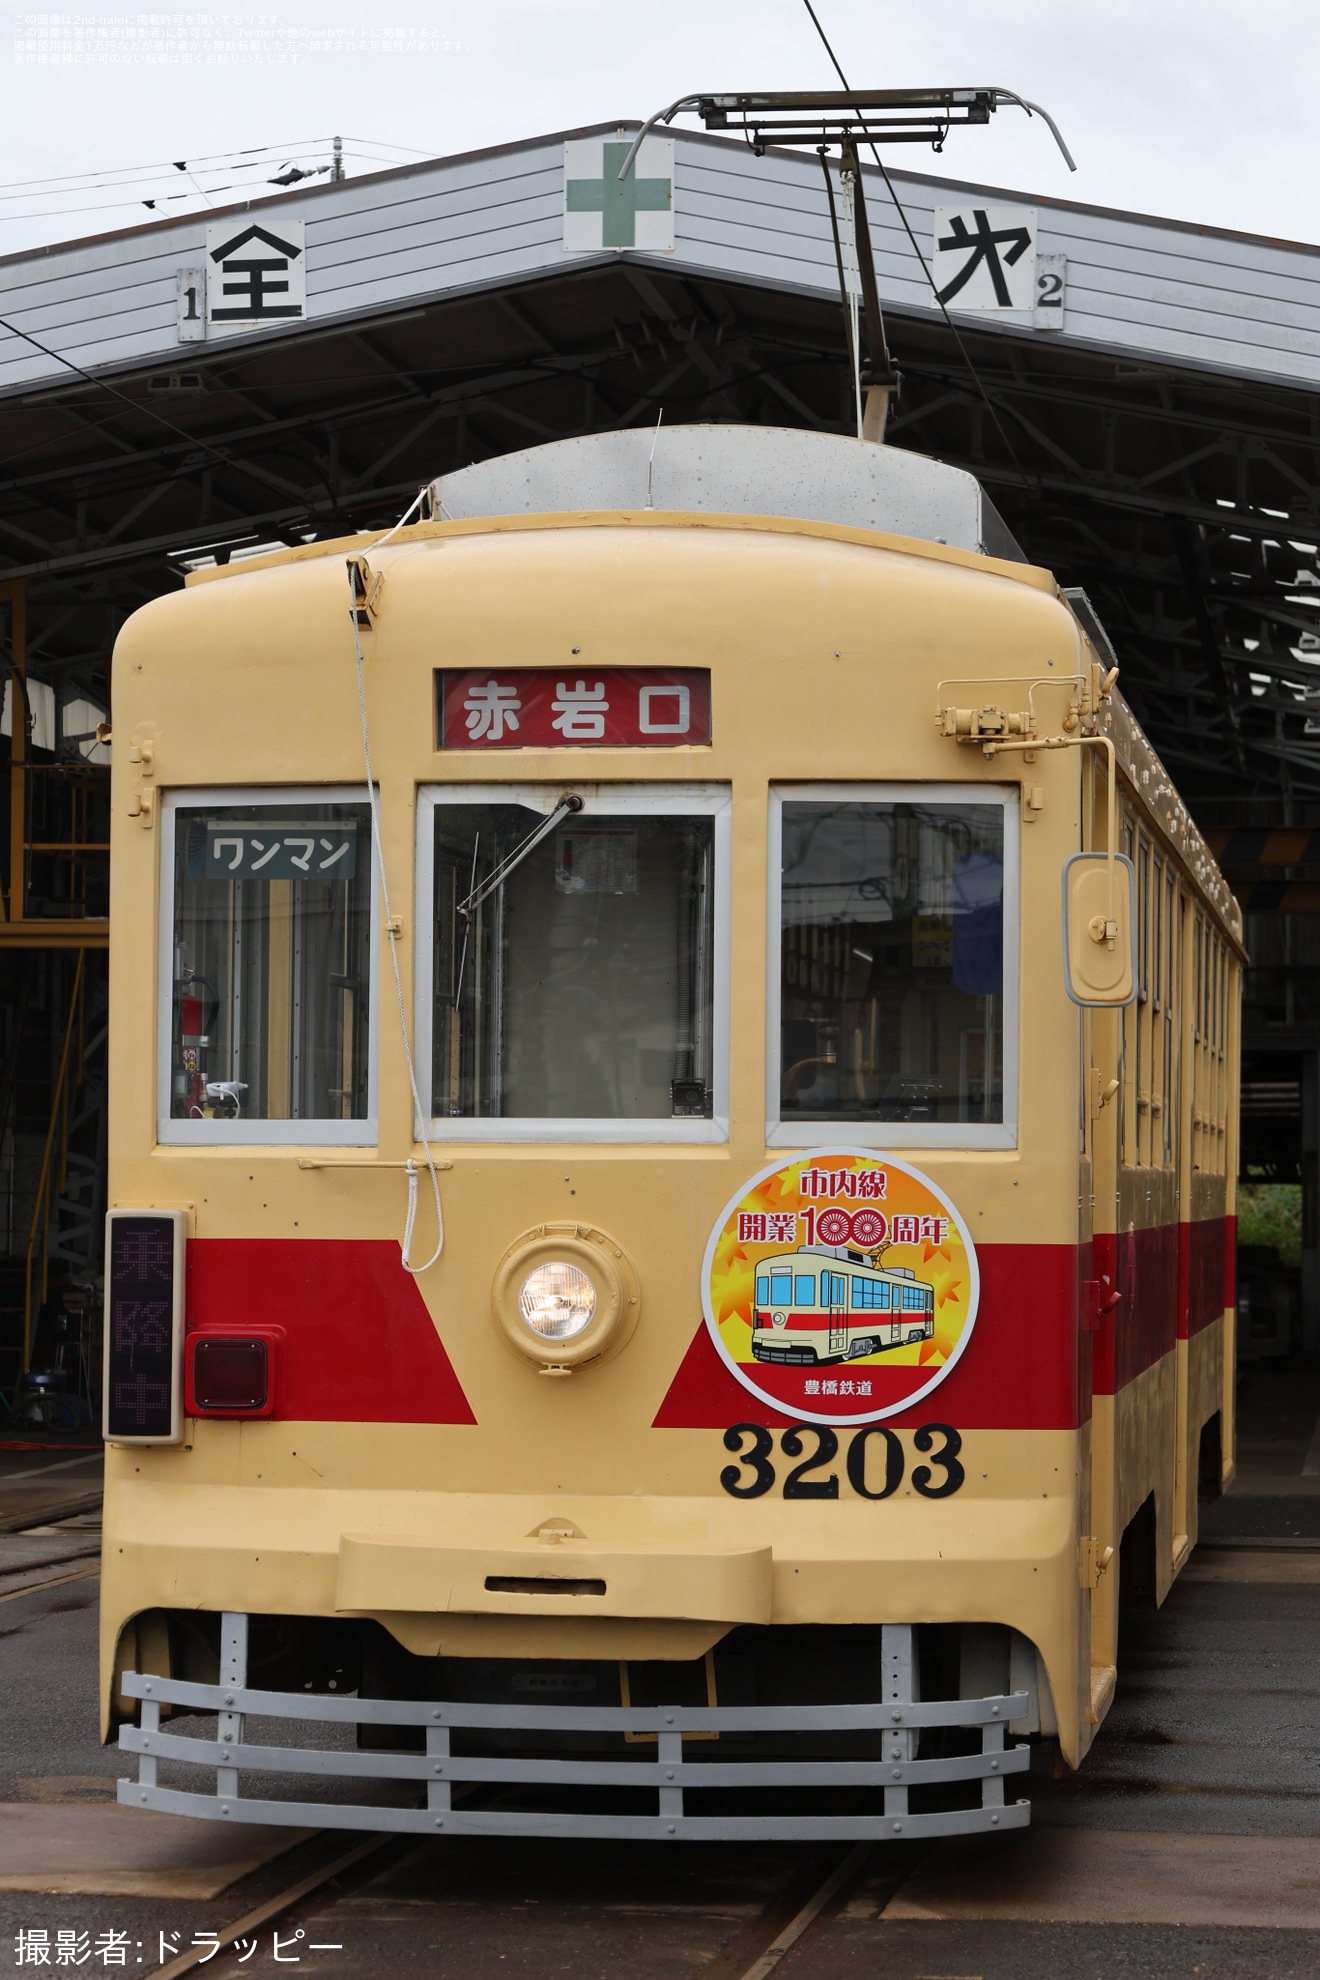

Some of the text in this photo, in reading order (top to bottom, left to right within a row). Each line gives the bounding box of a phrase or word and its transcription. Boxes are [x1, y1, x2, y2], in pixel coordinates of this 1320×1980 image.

[209, 224, 303, 321] 全
[183, 287, 201, 320] 1
[1037, 273, 1063, 308] 2
[463, 680, 690, 741] 赤岩口
[213, 837, 350, 871] ワンマン
[800, 1169, 886, 1198] 市内線
[803, 1380, 873, 1396] 豊橋鉄道
[720, 1422, 965, 1499] 3203
